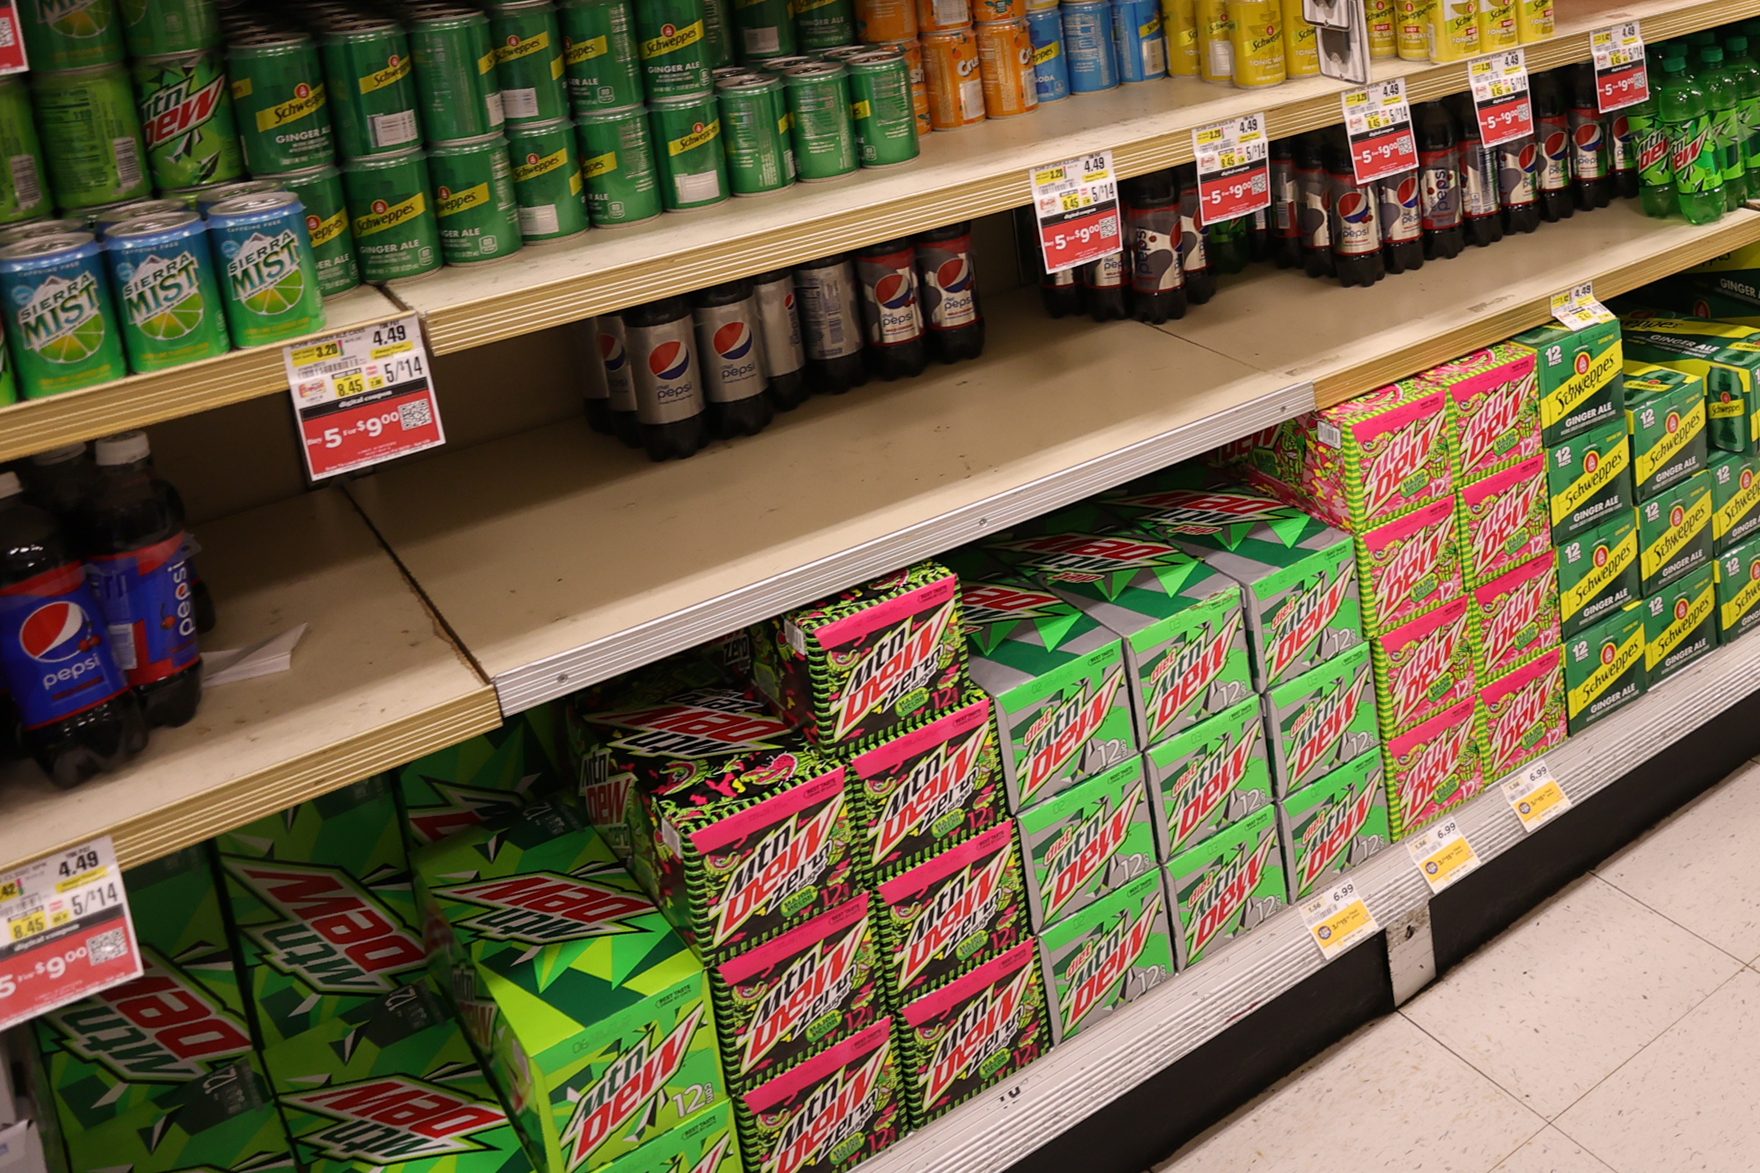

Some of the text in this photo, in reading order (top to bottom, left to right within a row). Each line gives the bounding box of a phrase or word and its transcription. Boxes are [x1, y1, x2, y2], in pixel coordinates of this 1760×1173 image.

[646, 27, 697, 55] Schweppes
[647, 61, 700, 75] GINGER ALE
[1383, 84, 1400, 96] 4.49
[1084, 158, 1105, 173] 4.49
[356, 202, 415, 235] Schweppes
[228, 230, 291, 274] SIERRA
[360, 239, 420, 256] GINGER ALE
[232, 238, 300, 301] MIST
[20, 271, 94, 321] SIERRA
[1719, 278, 1756, 299] GINGER
[23, 280, 99, 347] MIST
[373, 325, 407, 346] 4.49
[316, 343, 338, 358] 3.20
[1545, 345, 1563, 365] 12
[721, 362, 757, 381] pepsi
[337, 379, 363, 398] 8.45
[656, 383, 693, 403] pepsi
[1555, 356, 1616, 415] Schweppes
[1565, 402, 1613, 427] GINGER ALE
[1640, 409, 1656, 424] 12
[323, 427, 343, 449] 5
[1649, 411, 1702, 472] Schweppes
[1566, 449, 1623, 511] Schweppes
[1656, 457, 1697, 483] GINGER ALE
[1430, 481, 1446, 498] 12
[167, 559, 196, 637] pepsi
[42, 653, 101, 690] pepsi
[848, 627, 907, 697] Mtn
[931, 688, 953, 710] 12
[1025, 710, 1052, 740] diet
[1030, 704, 1080, 759] Mtn
[1098, 739, 1121, 766] 12
[58, 850, 99, 878] 4.49
[1333, 884, 1355, 902] 6.99
[566, 1044, 645, 1135] Mtn
[672, 1083, 706, 1119] 12
